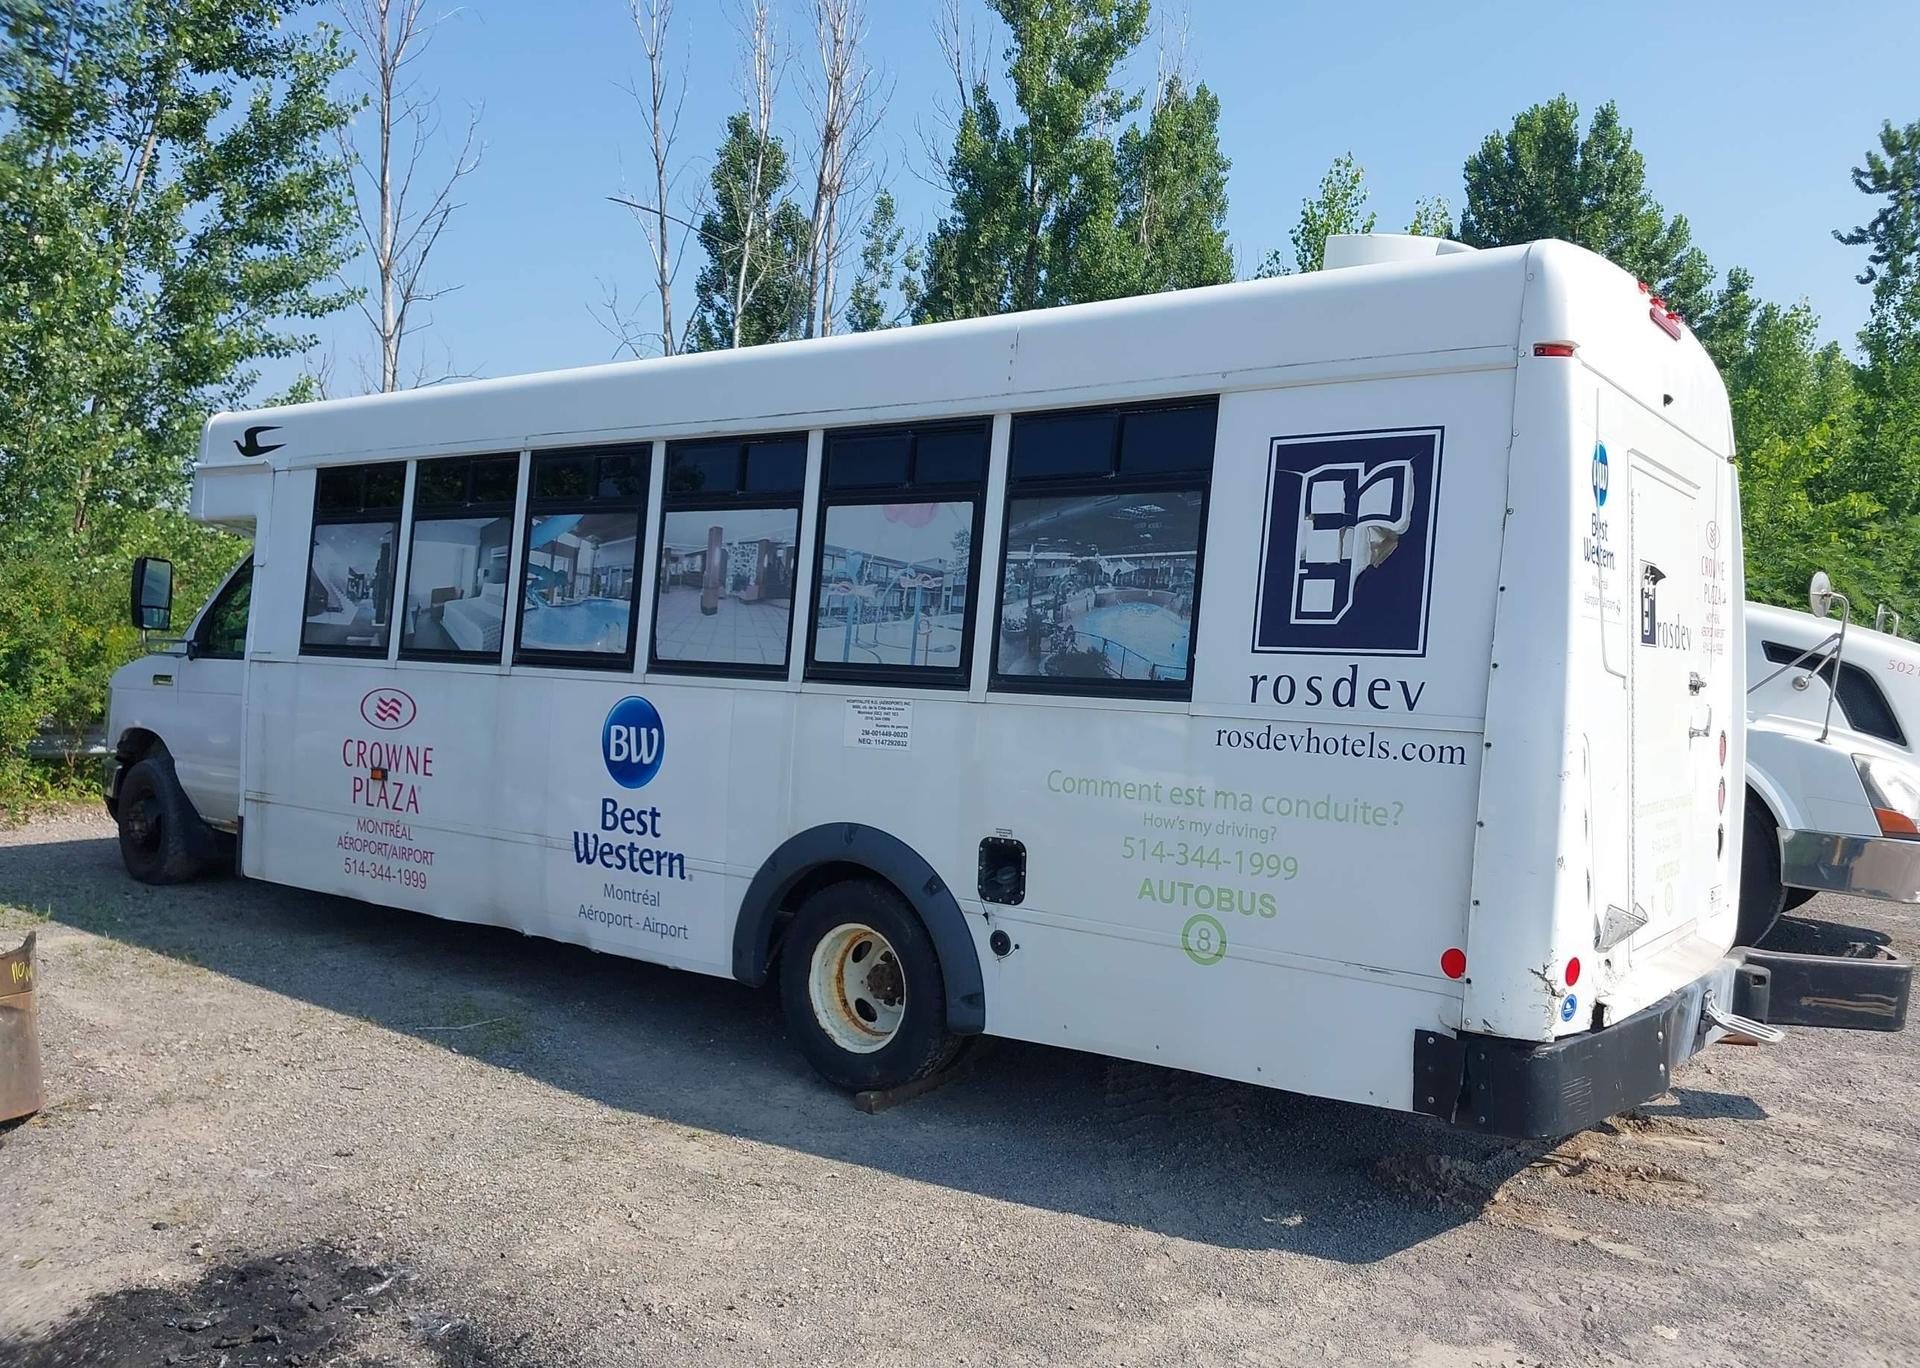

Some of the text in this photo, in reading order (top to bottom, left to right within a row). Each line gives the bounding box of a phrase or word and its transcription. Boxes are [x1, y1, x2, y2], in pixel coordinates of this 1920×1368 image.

[1657, 613, 1691, 651] rosdev
[1887, 659, 1920, 677] 502
[1249, 664, 1426, 711] rosdev
[343, 739, 434, 777] CROWNE
[609, 725, 659, 765] BW
[1215, 724, 1468, 766] rosdevhotels.com
[353, 776, 420, 815] PLAZA
[1047, 769, 1405, 826] Comment est ma conduite?
[356, 816, 414, 842] MONTRÉAL
[601, 798, 661, 838] Best
[1143, 812, 1277, 844] How's my driving?
[337, 831, 435, 866] AÉROPORT/AIRPORT
[573, 831, 686, 881] Western
[1121, 835, 1298, 881] 514-344-1999
[344, 857, 427, 890] 514-344-1999
[603, 883, 661, 908] Montréal
[1137, 877, 1278, 919] AUTOBUS
[578, 903, 633, 929] Aéroport
[642, 916, 689, 941] Airport
[1196, 928, 1212, 951] 8
